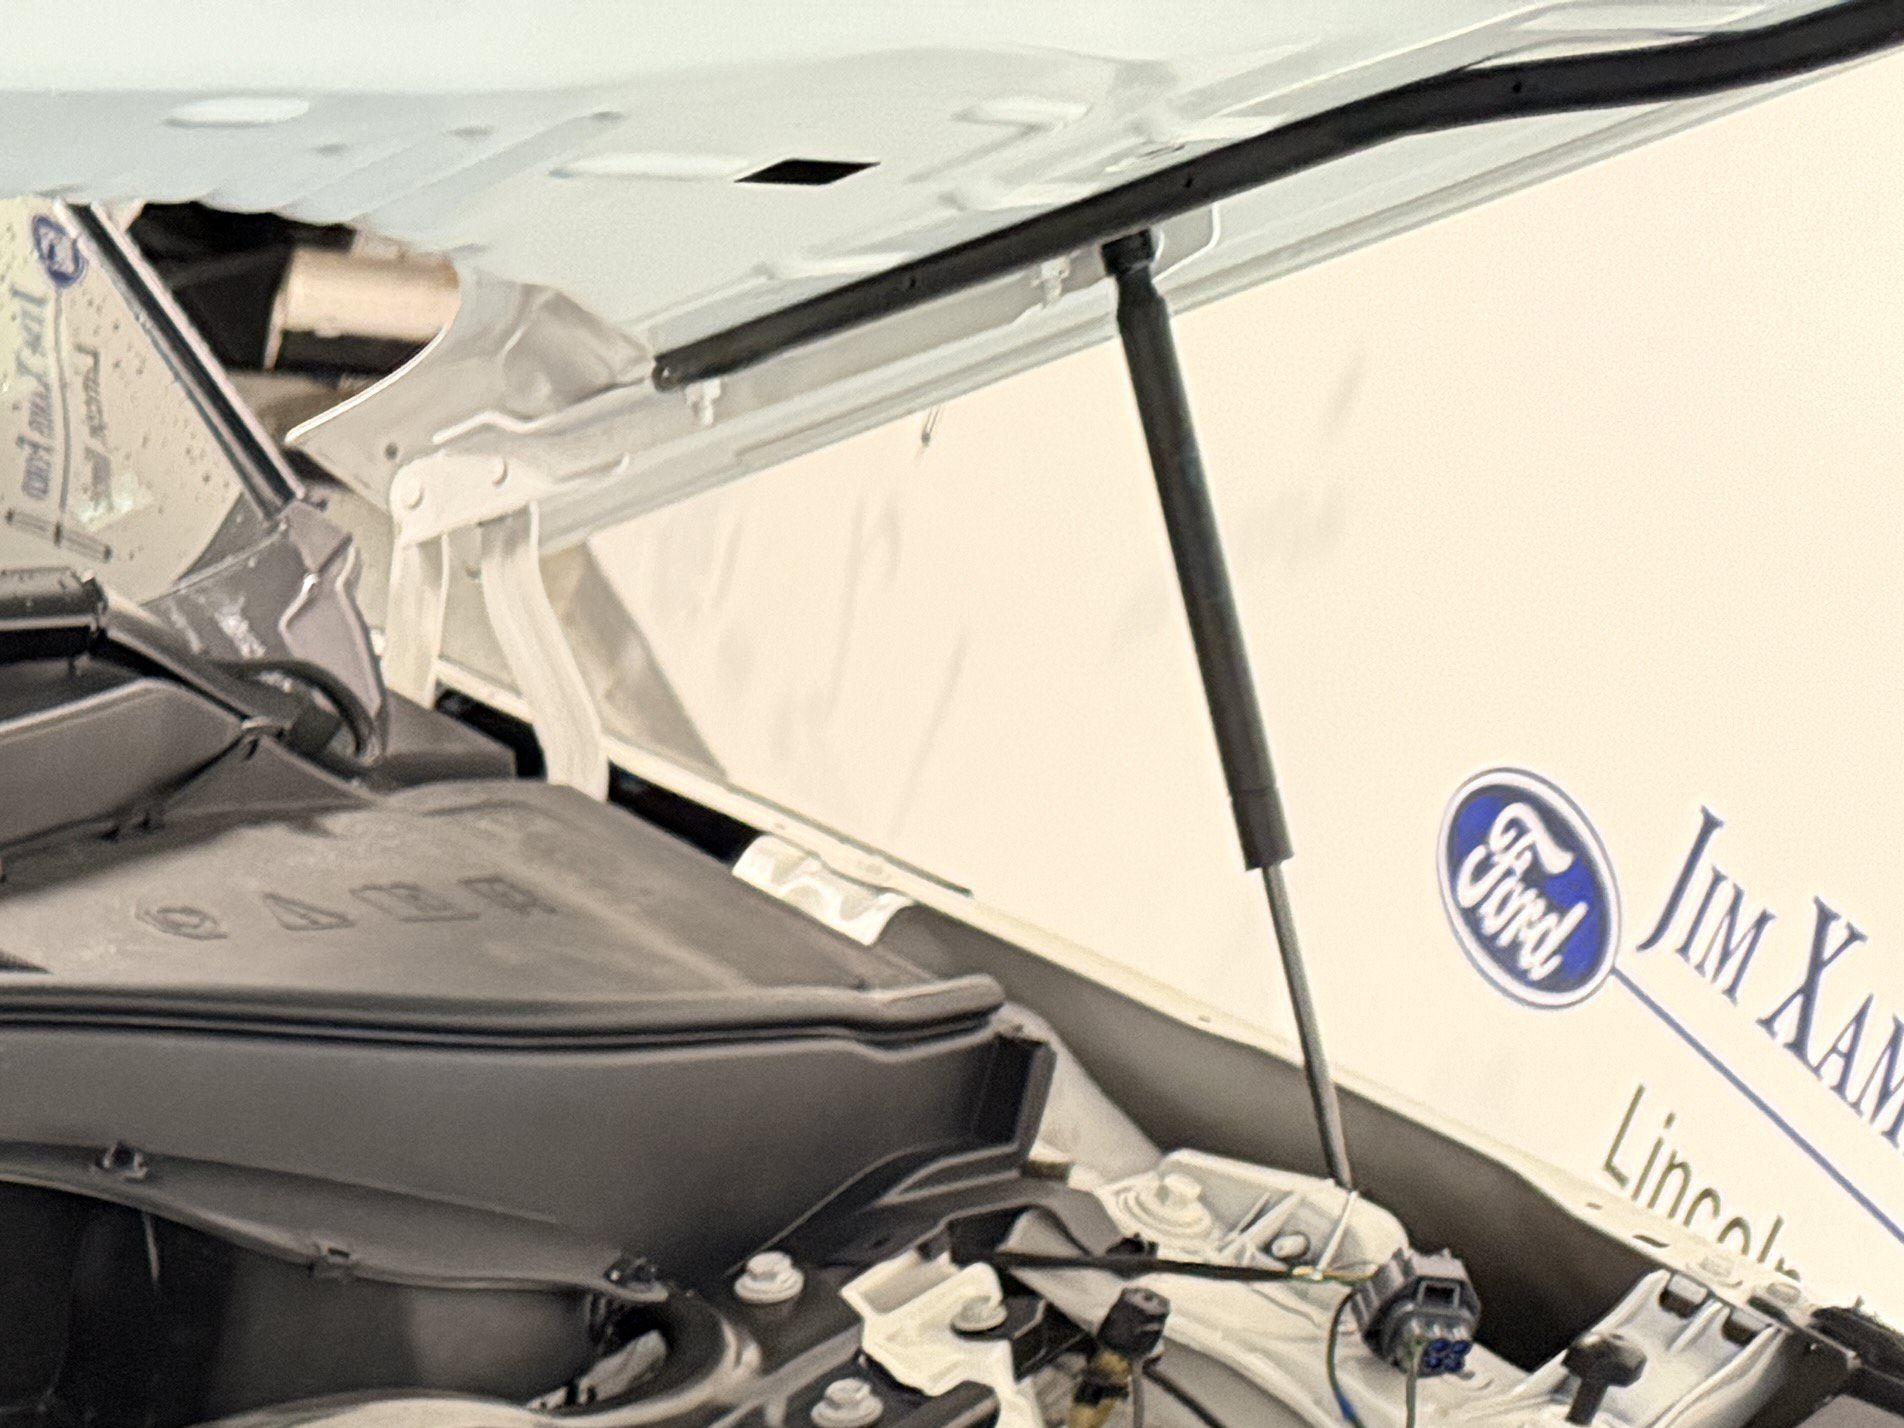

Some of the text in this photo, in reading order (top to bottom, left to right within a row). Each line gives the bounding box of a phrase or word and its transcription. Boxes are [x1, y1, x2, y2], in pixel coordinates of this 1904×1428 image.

[1457, 801, 1589, 982] Ford
[1636, 805, 1776, 1006] JIM
[1603, 1084, 1802, 1282] Lincol
